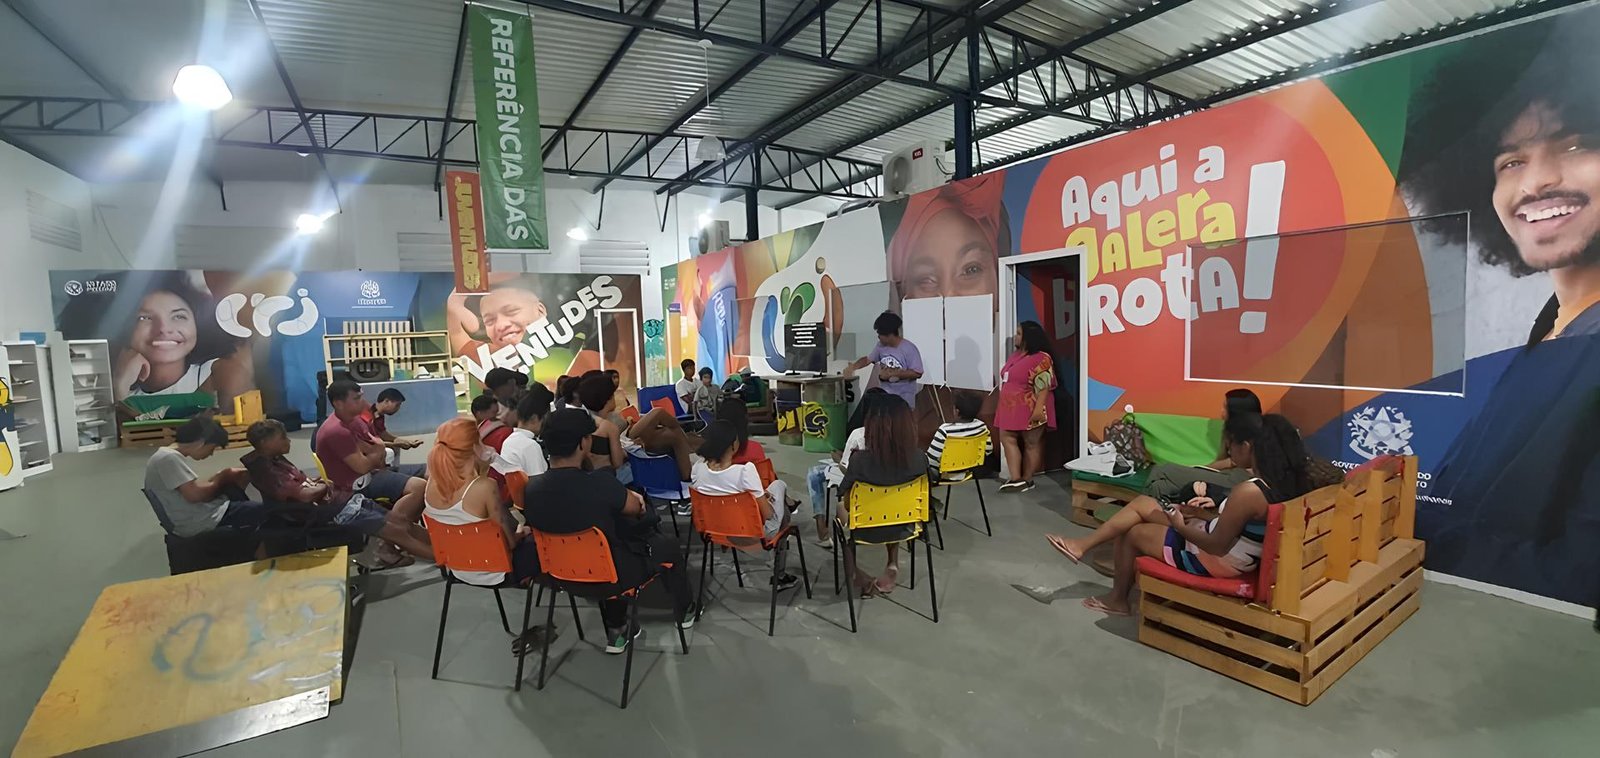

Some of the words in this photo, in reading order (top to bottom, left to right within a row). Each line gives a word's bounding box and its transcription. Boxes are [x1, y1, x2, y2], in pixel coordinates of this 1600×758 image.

[490, 18, 525, 180] REFERÊNCIA
[502, 186, 529, 241] DAS
[1061, 143, 1179, 230] Aqui
[1193, 145, 1225, 183] a
